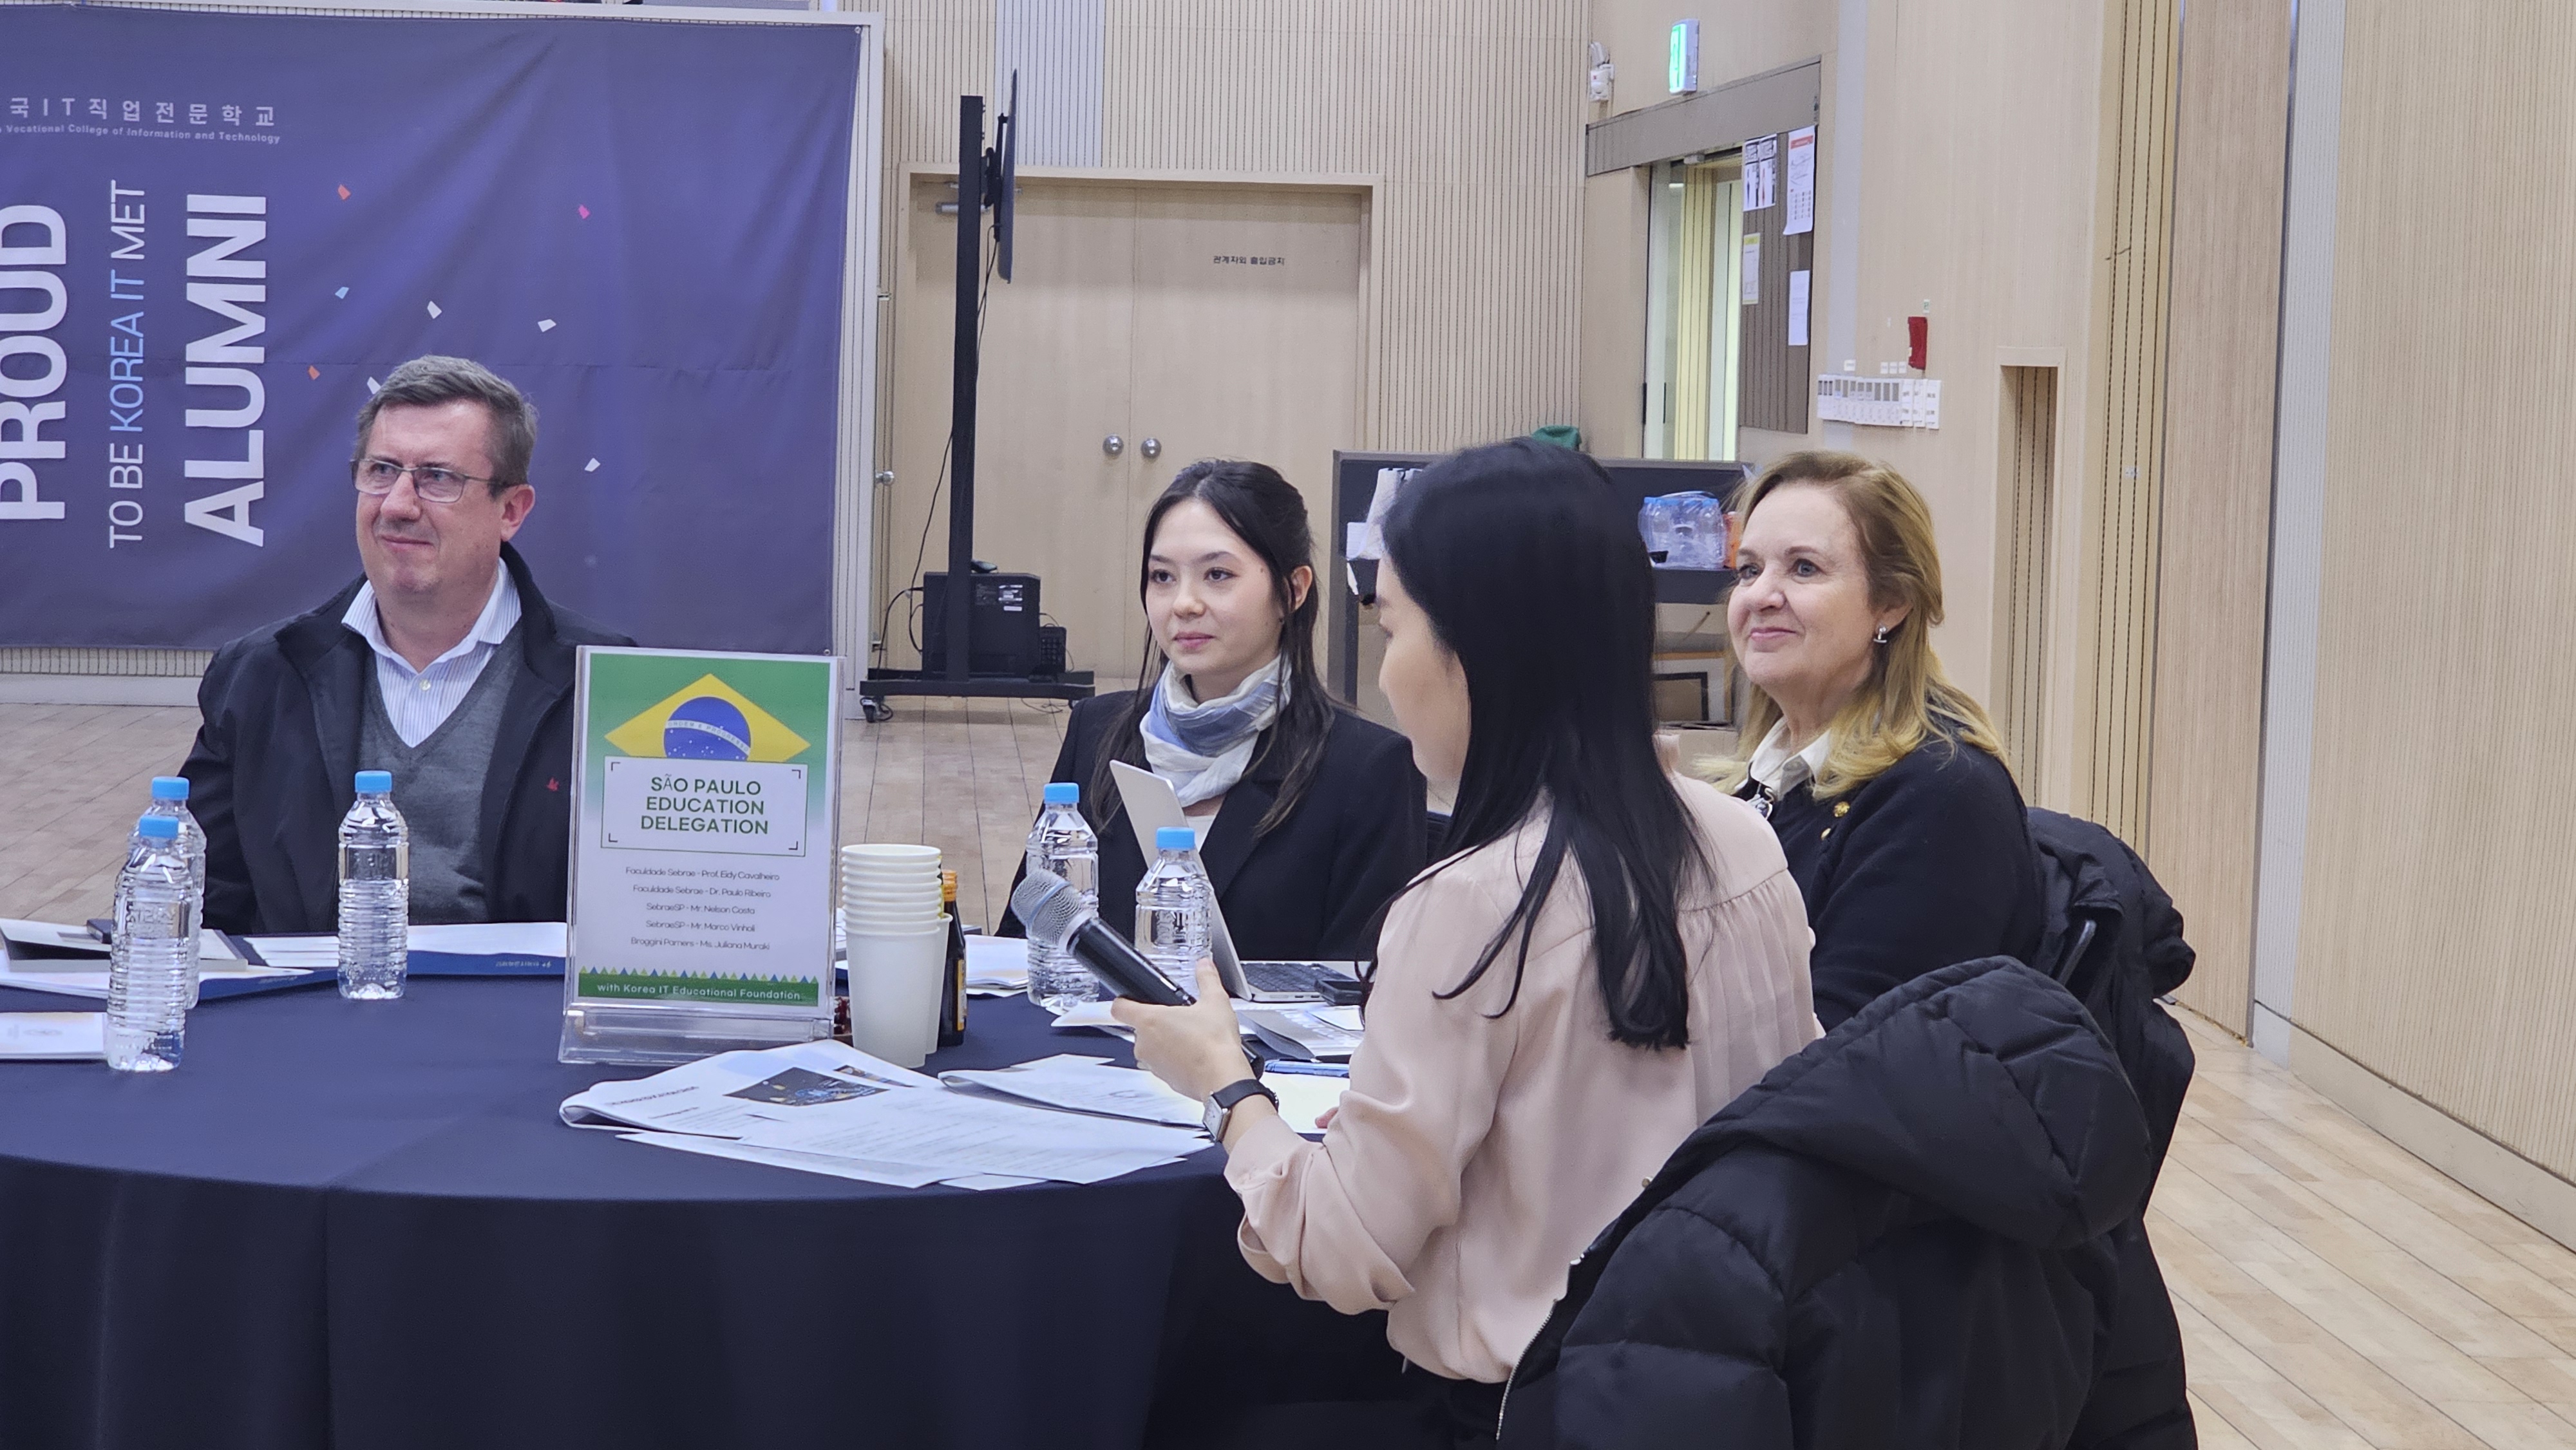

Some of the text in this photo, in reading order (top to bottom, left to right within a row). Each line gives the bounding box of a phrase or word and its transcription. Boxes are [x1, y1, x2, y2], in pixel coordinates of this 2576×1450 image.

[6, 124, 64, 133] Vocational
[68, 124, 108, 136] College
[127, 127, 191, 139] Information
[194, 131, 214, 140] and
[219, 131, 280, 144] Technology
[0, 205, 67, 520] PROUD
[109, 179, 145, 549] TO BE KOREA IT MET
[185, 194, 266, 547] ALUMNI
[651, 773, 761, 795] SÃO PAULO
[646, 796, 764, 815] EDUCATION
[641, 814, 768, 834] DELEGATION
[626, 867, 667, 876] Faculdade
[667, 868, 696, 876] Sebrae
[633, 885, 674, 894] Faculdade
[675, 886, 703, 895] Sebrae
[710, 887, 721, 896] Dr.
[744, 889, 771, 898] Ribeiro
[646, 902, 685, 911] SebraeSP
[704, 905, 730, 914] Nelson
[732, 906, 755, 914] Costa
[646, 920, 685, 929] SebraeSP
[691, 922, 703, 930] Mr.
[705, 923, 730, 931] Marco
[597, 983, 800, 1000] with Korea IT Educational Foundation
